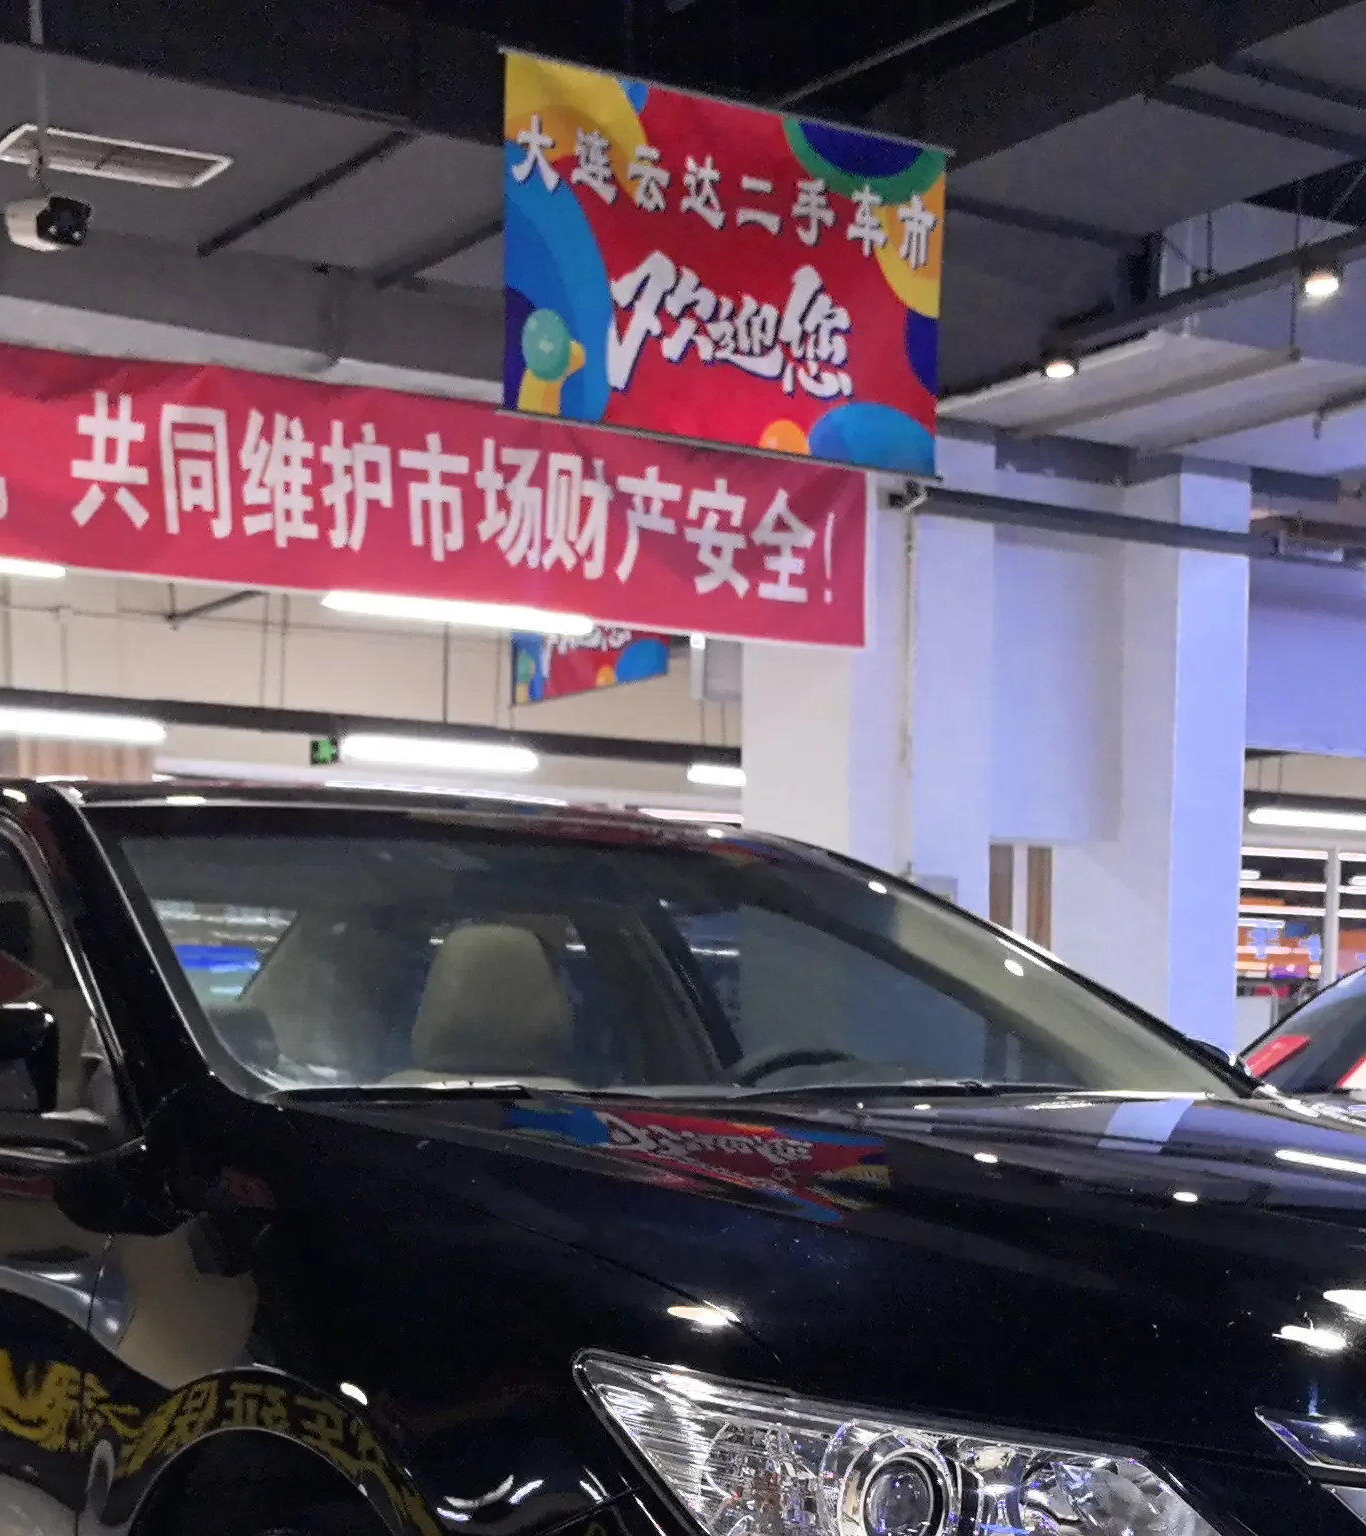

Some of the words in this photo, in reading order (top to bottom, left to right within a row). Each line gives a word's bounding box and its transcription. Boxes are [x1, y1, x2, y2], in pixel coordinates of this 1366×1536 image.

[512, 113, 937, 270] 大连云达二手车市
[605, 249, 855, 399] 欢迎您
